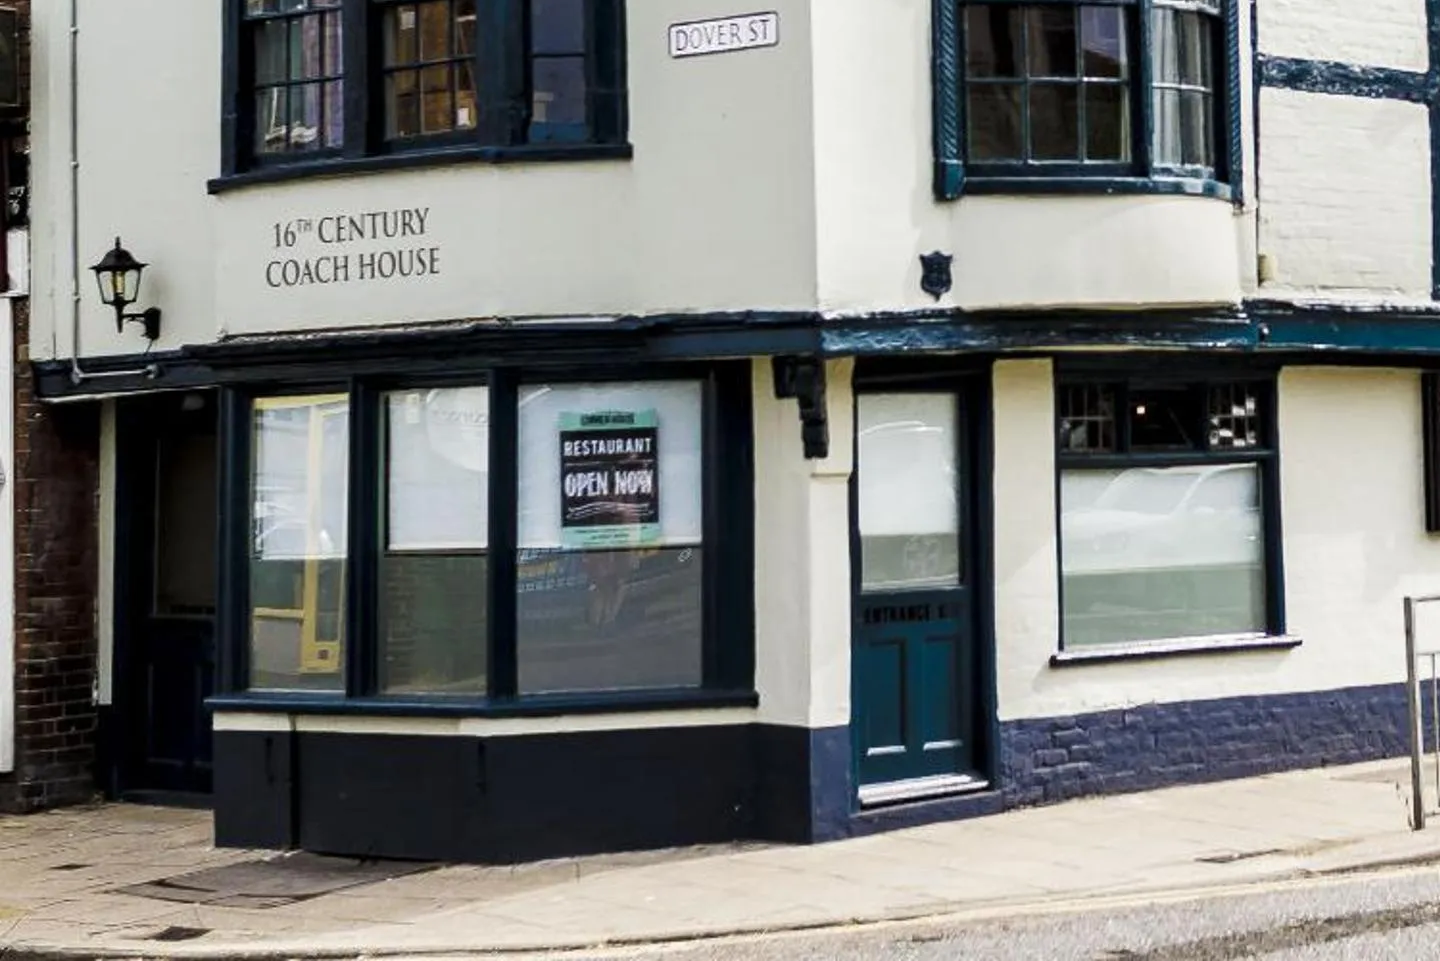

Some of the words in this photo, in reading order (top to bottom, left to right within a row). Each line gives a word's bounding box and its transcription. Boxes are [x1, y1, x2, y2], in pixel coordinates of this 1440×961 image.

[676, 23, 741, 50] DOVER
[748, 19, 770, 41] ST
[318, 207, 430, 243] CENTURY
[266, 255, 350, 288] COACH
[358, 247, 441, 280] HOUSE
[564, 438, 652, 456] RESTAURANT
[565, 471, 609, 498] OPEN
[615, 470, 653, 495] NOW
